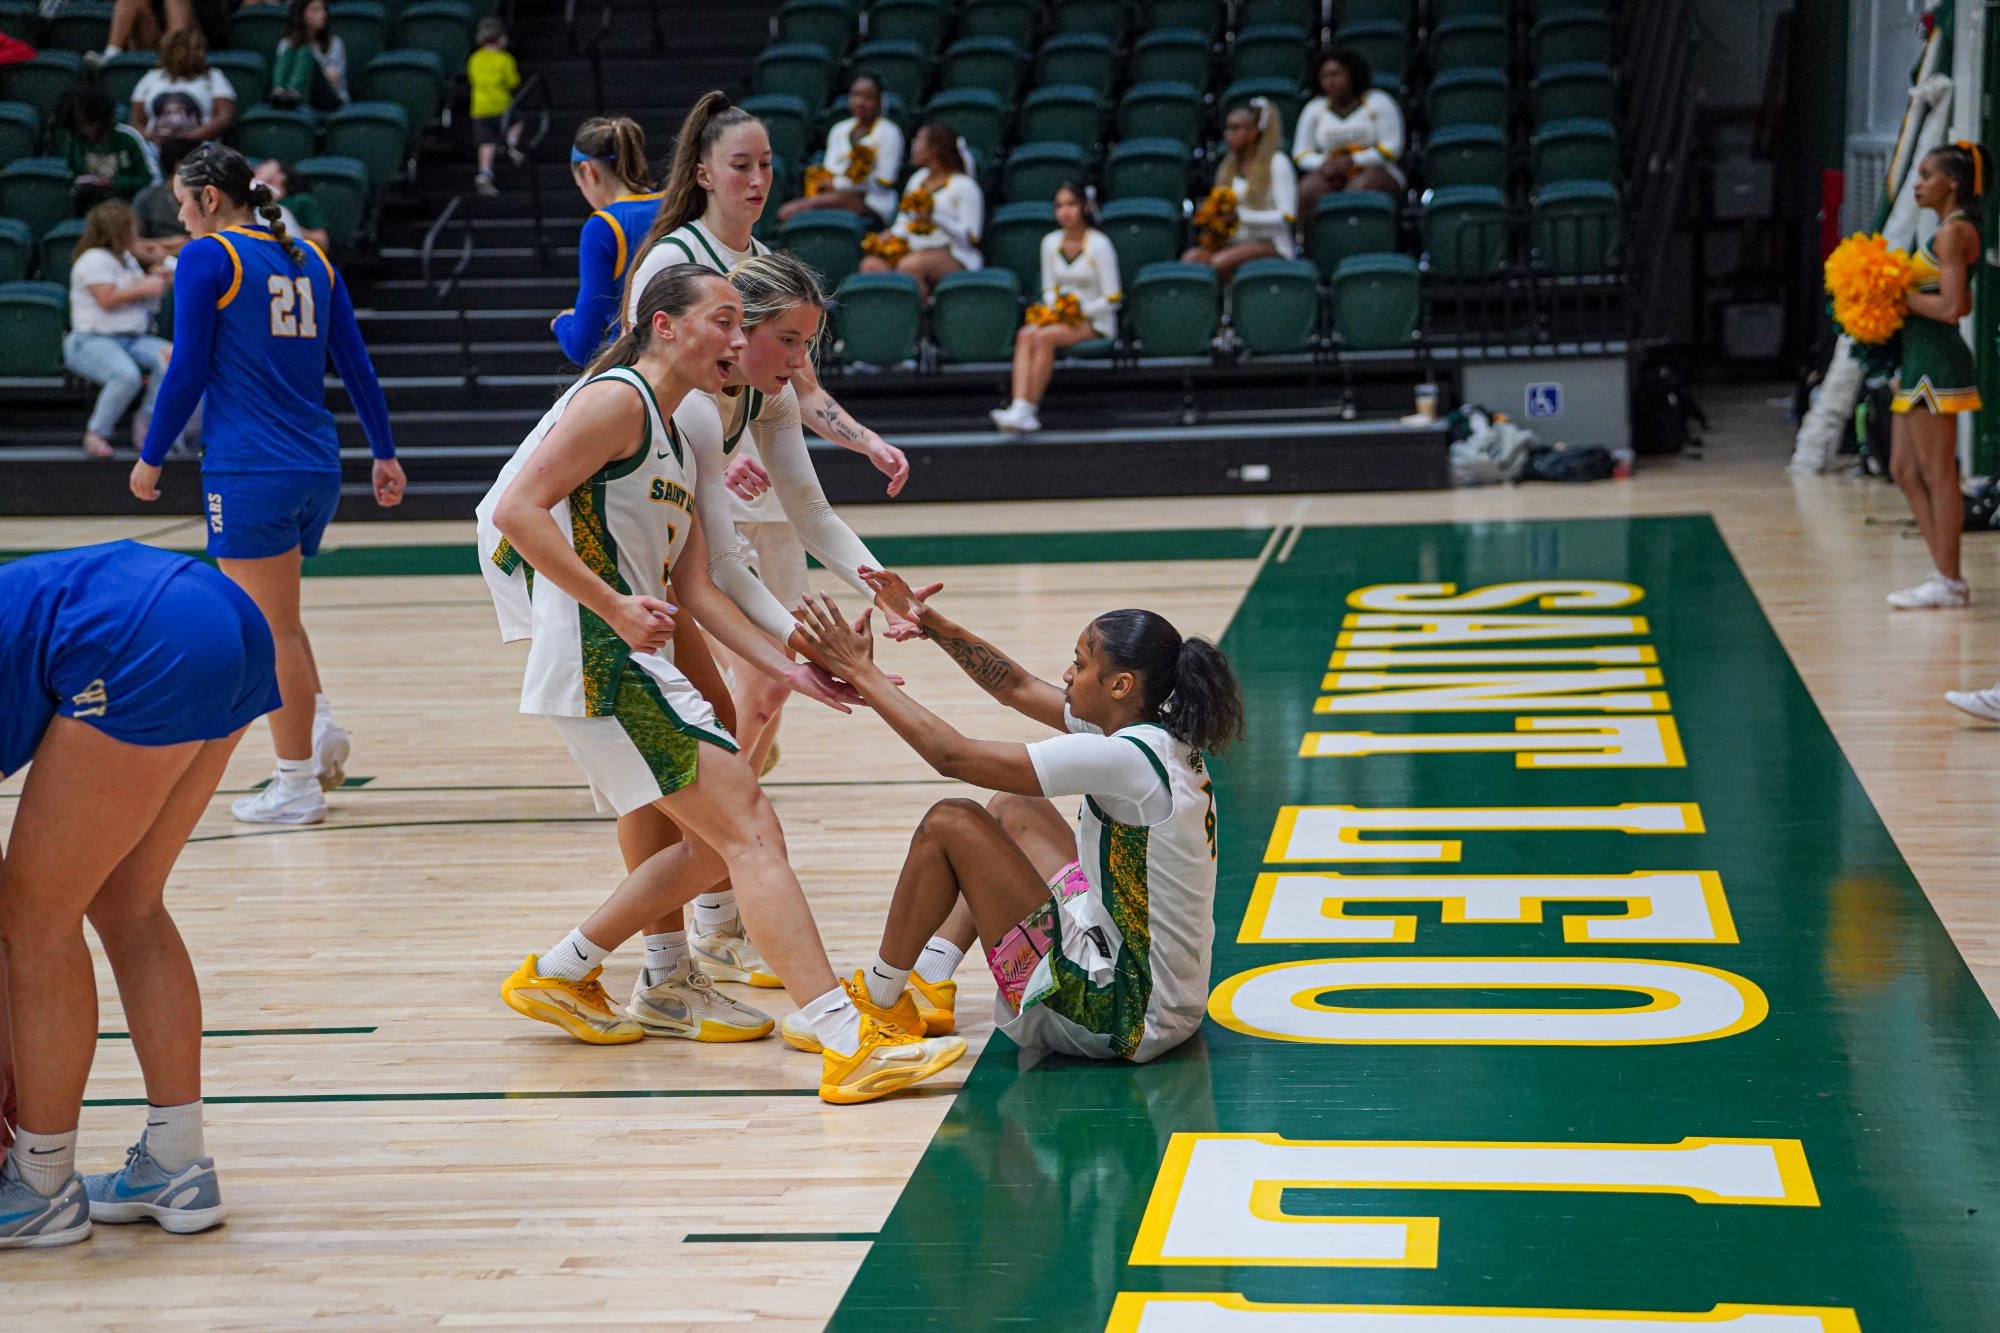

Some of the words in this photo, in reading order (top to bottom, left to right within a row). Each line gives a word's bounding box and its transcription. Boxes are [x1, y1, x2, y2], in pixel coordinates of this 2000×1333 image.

[267, 274, 317, 338] 21
[1298, 579, 1688, 769] SAINT
[1206, 801, 1770, 1046] LEO
